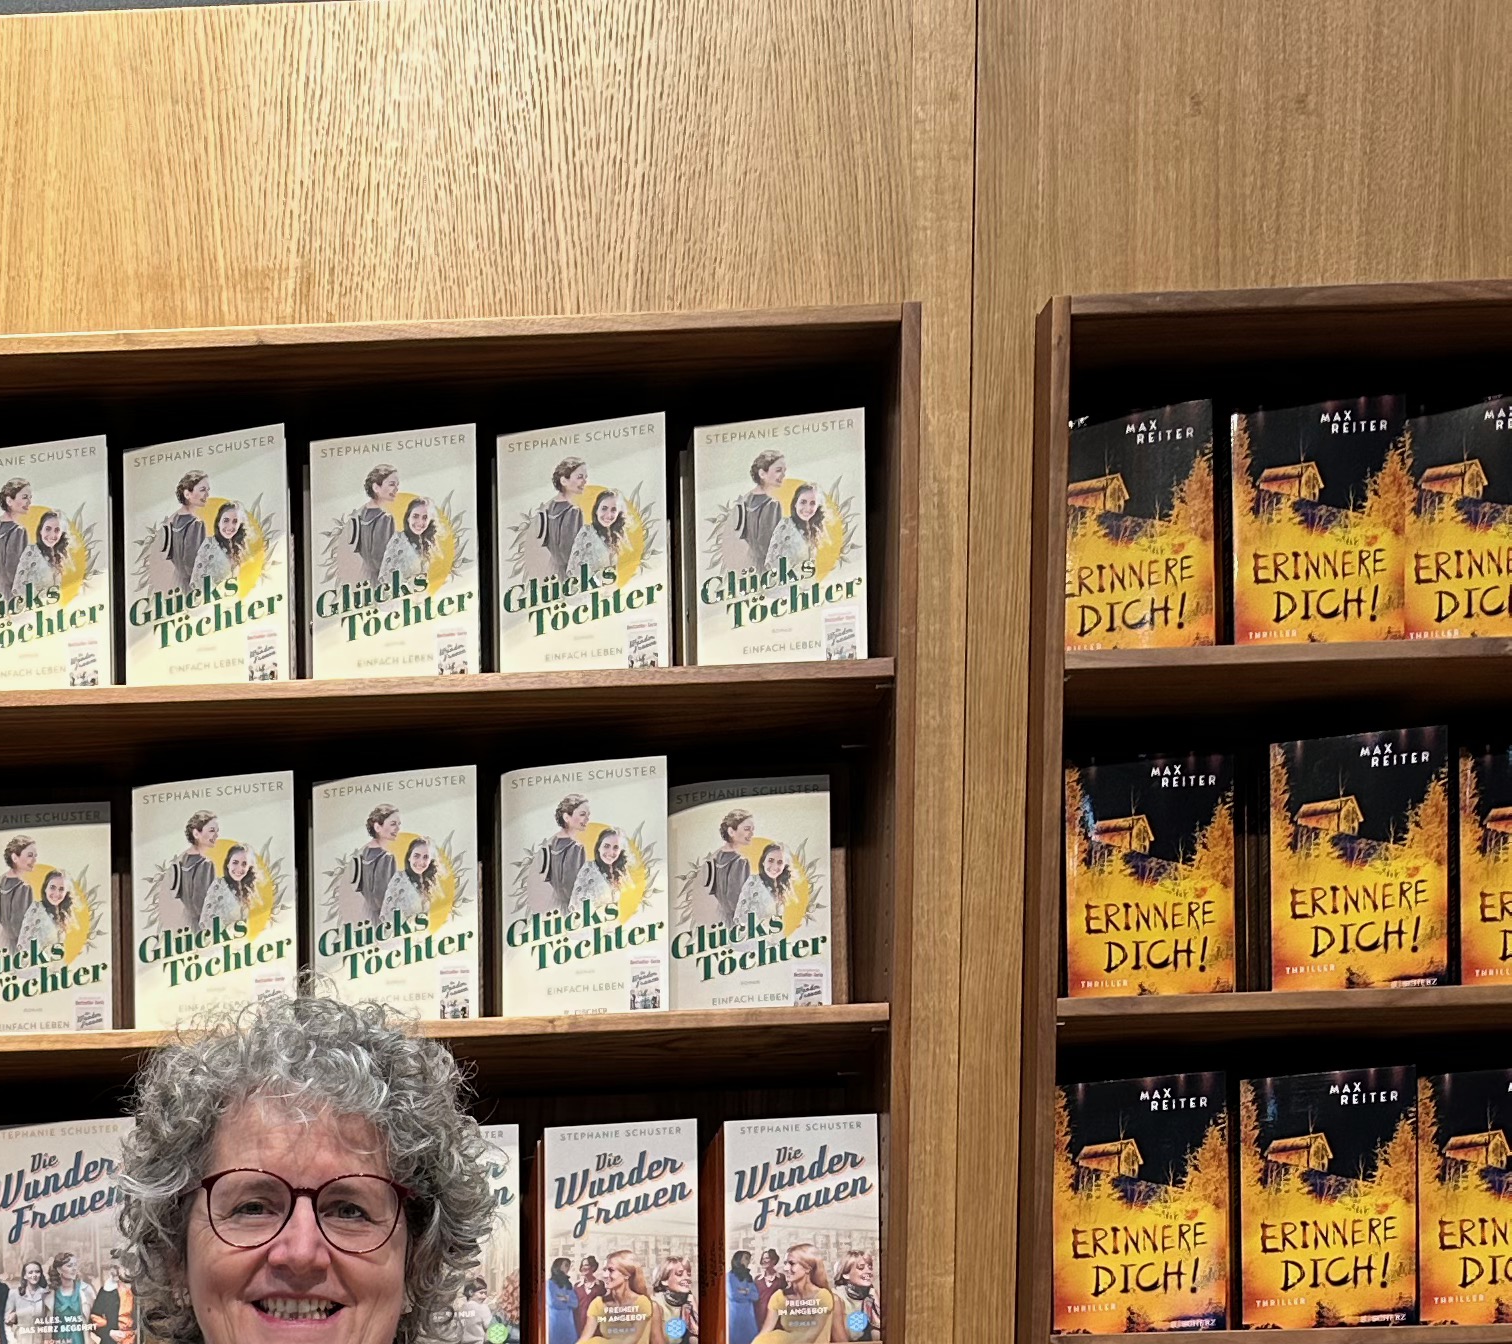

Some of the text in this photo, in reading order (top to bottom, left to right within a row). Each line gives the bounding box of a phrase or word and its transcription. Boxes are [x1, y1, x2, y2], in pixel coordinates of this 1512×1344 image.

[1321, 410, 1352, 423] MAX
[1331, 419, 1388, 434] REITER
[705, 418, 855, 445] STEPHANIE SCHUSTER
[1253, 548, 1386, 584] ERINNERE
[701, 556, 817, 607] Glücks
[726, 576, 864, 629] Töchter
[1273, 584, 1380, 623] DICH!
[743, 640, 822, 655] EINFACH LEBEN
[1360, 743, 1392, 757] MAX
[1371, 751, 1430, 768] REITER
[511, 765, 657, 790] STEPHANIE SCHUSTER
[1290, 880, 1429, 920] ERINNERE
[506, 899, 620, 949] Glücks
[1310, 915, 1422, 958] DICH!
[531, 918, 665, 972] Töchter
[547, 980, 626, 996] EINFACH LEBEN
[740, 1120, 862, 1135] STEPHANIE SCHUSTER
[30, 1152, 59, 1174] Die
[775, 1145, 803, 1165] Die
[735, 1144, 865, 1204] Wunder
[753, 1175, 873, 1232] Frauen
